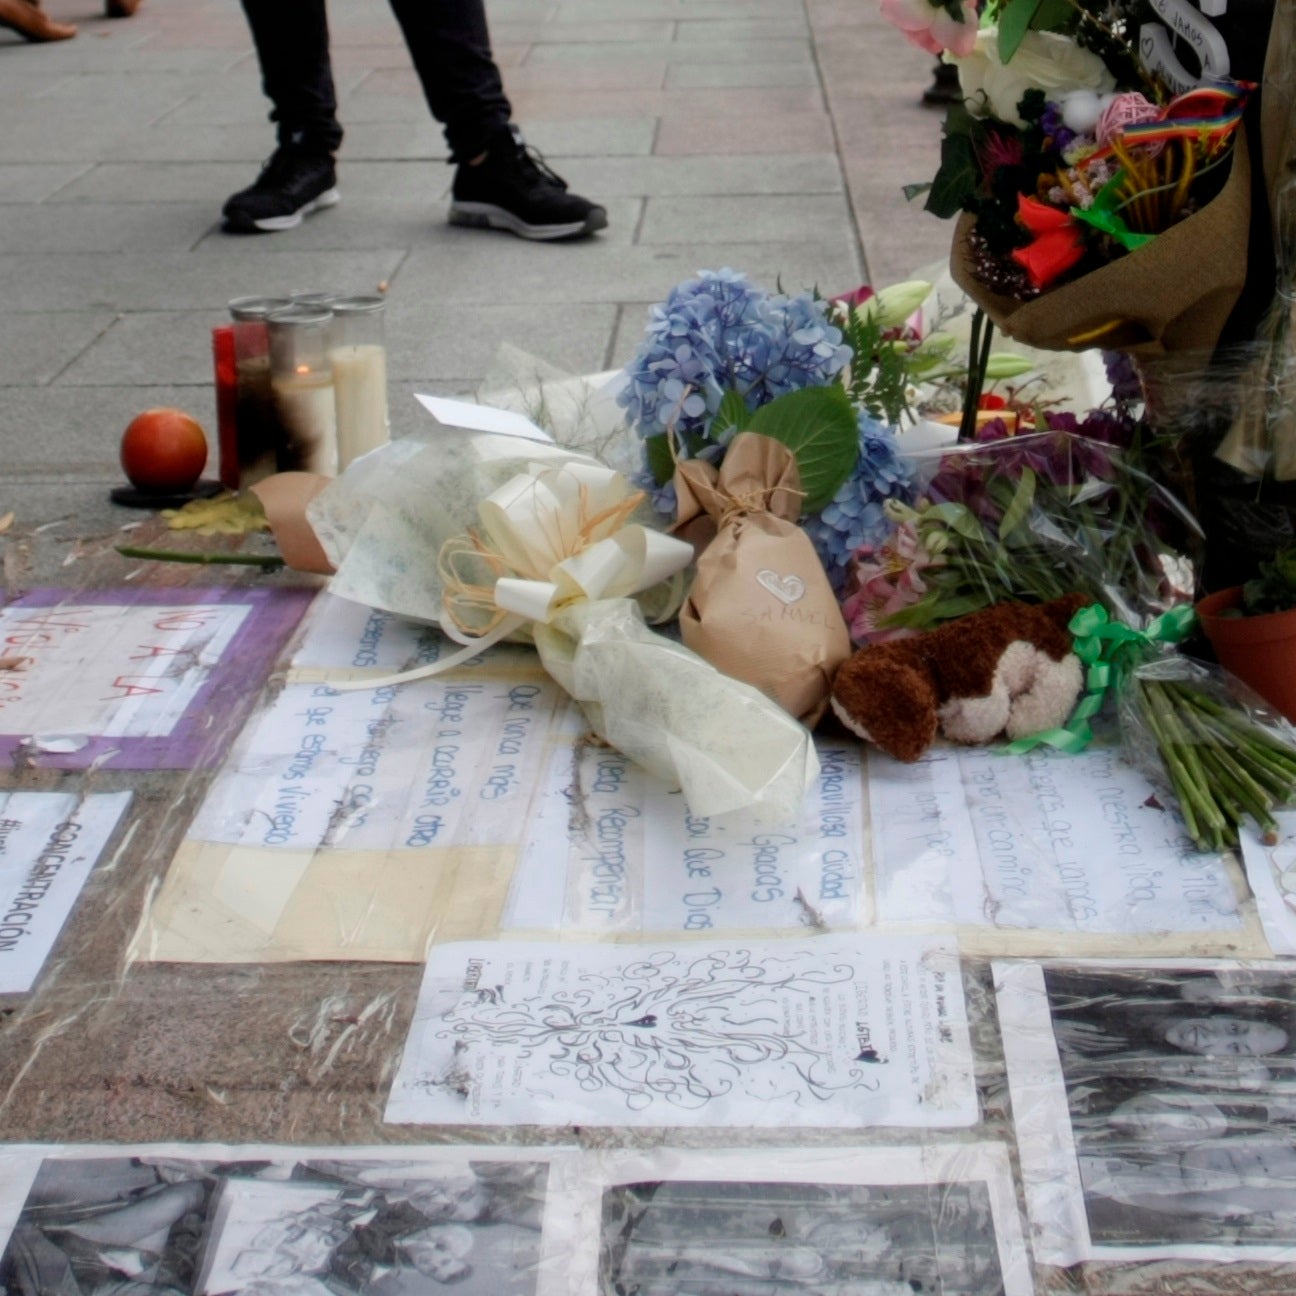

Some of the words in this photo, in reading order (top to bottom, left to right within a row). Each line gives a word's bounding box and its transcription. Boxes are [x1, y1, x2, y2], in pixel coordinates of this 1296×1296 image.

[1172, 11, 1204, 47] VAMOS
[154, 608, 218, 632] NO
[740, 604, 836, 631] SAMUEL
[479, 763, 522, 801] más
